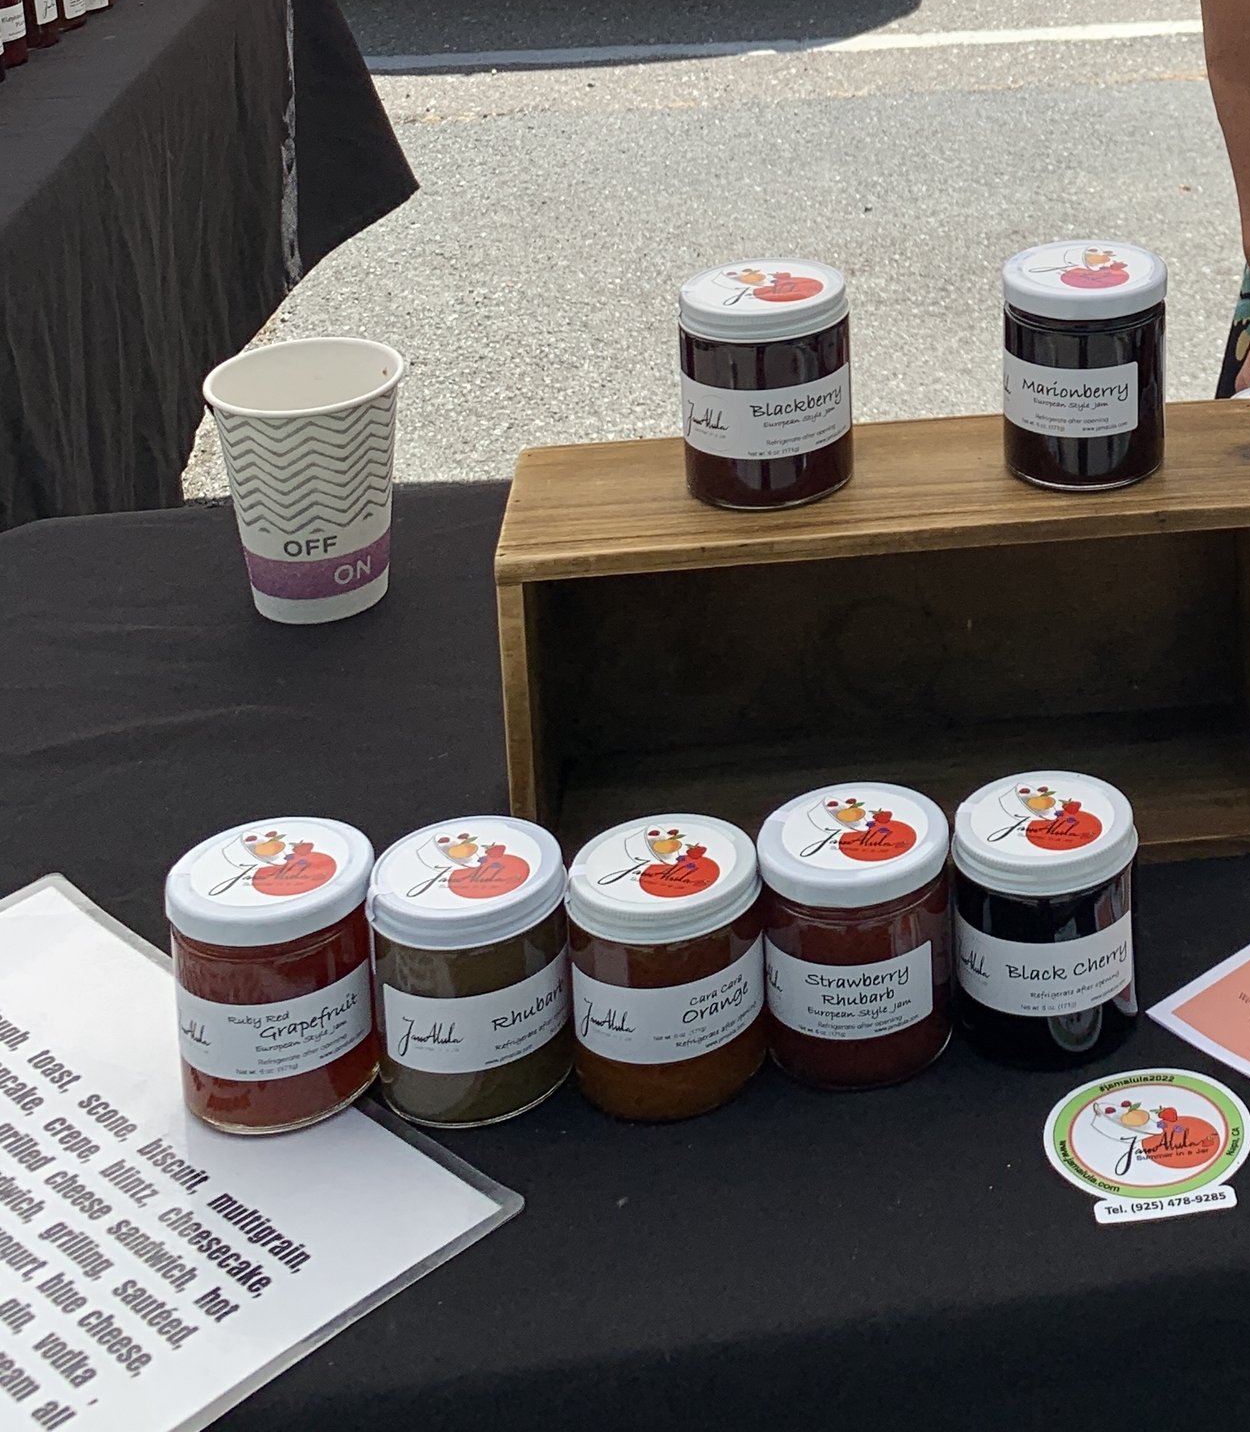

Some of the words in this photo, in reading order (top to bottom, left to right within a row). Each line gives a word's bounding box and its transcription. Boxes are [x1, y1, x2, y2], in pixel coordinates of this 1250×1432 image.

[750, 386, 842, 418] Blackberry
[1022, 378, 1129, 401] Marionberry
[283, 536, 338, 557] OFF
[334, 555, 372, 585] ON
[1005, 964, 1067, 981] Black
[1073, 940, 1129, 976] Cherry
[689, 990, 718, 1007] Cara
[721, 974, 743, 993] Cara
[805, 966, 910, 989] Strawberry
[682, 981, 749, 1025] Orange
[807, 1005, 856, 1020] European
[857, 1005, 888, 1020] Style
[821, 988, 895, 1006] Rhubarb
[1238, 992, 1250, 1005] We
[228, 1015, 262, 1029] Ruby
[266, 1011, 290, 1024] Red
[259, 993, 359, 1041] Grapefruit
[398, 1017, 464, 1057] JamAlula
[1099, 1074, 1175, 1092] #jamalula2022
[27, 1049, 82, 1094] toast,
[77, 1093, 138, 1143] scone,
[137, 1138, 211, 1195] biscuit,
[206, 1192, 312, 1274] multigrain,
[1136, 1151, 1173, 1162] Summer
[43, 1117, 101, 1164] crepe,
[98, 1159, 160, 1208] blintz,
[157, 1207, 273, 1300] cheesecake,
[1105, 1205, 1127, 1215] Tel.
[1131, 1201, 1164, 1214] (925)
[1168, 1192, 1226, 1208] 478-9285
[43, 1170, 113, 1221] cheese
[106, 1219, 198, 1294] sandwich,
[194, 1285, 241, 1324] hot
[37, 1221, 115, 1282] grilling,
[112, 1279, 200, 1351] sautéed,
[35, 1271, 89, 1314] blue
[76, 1309, 153, 1379] cheese,
[30, 1400, 78, 1432] all
